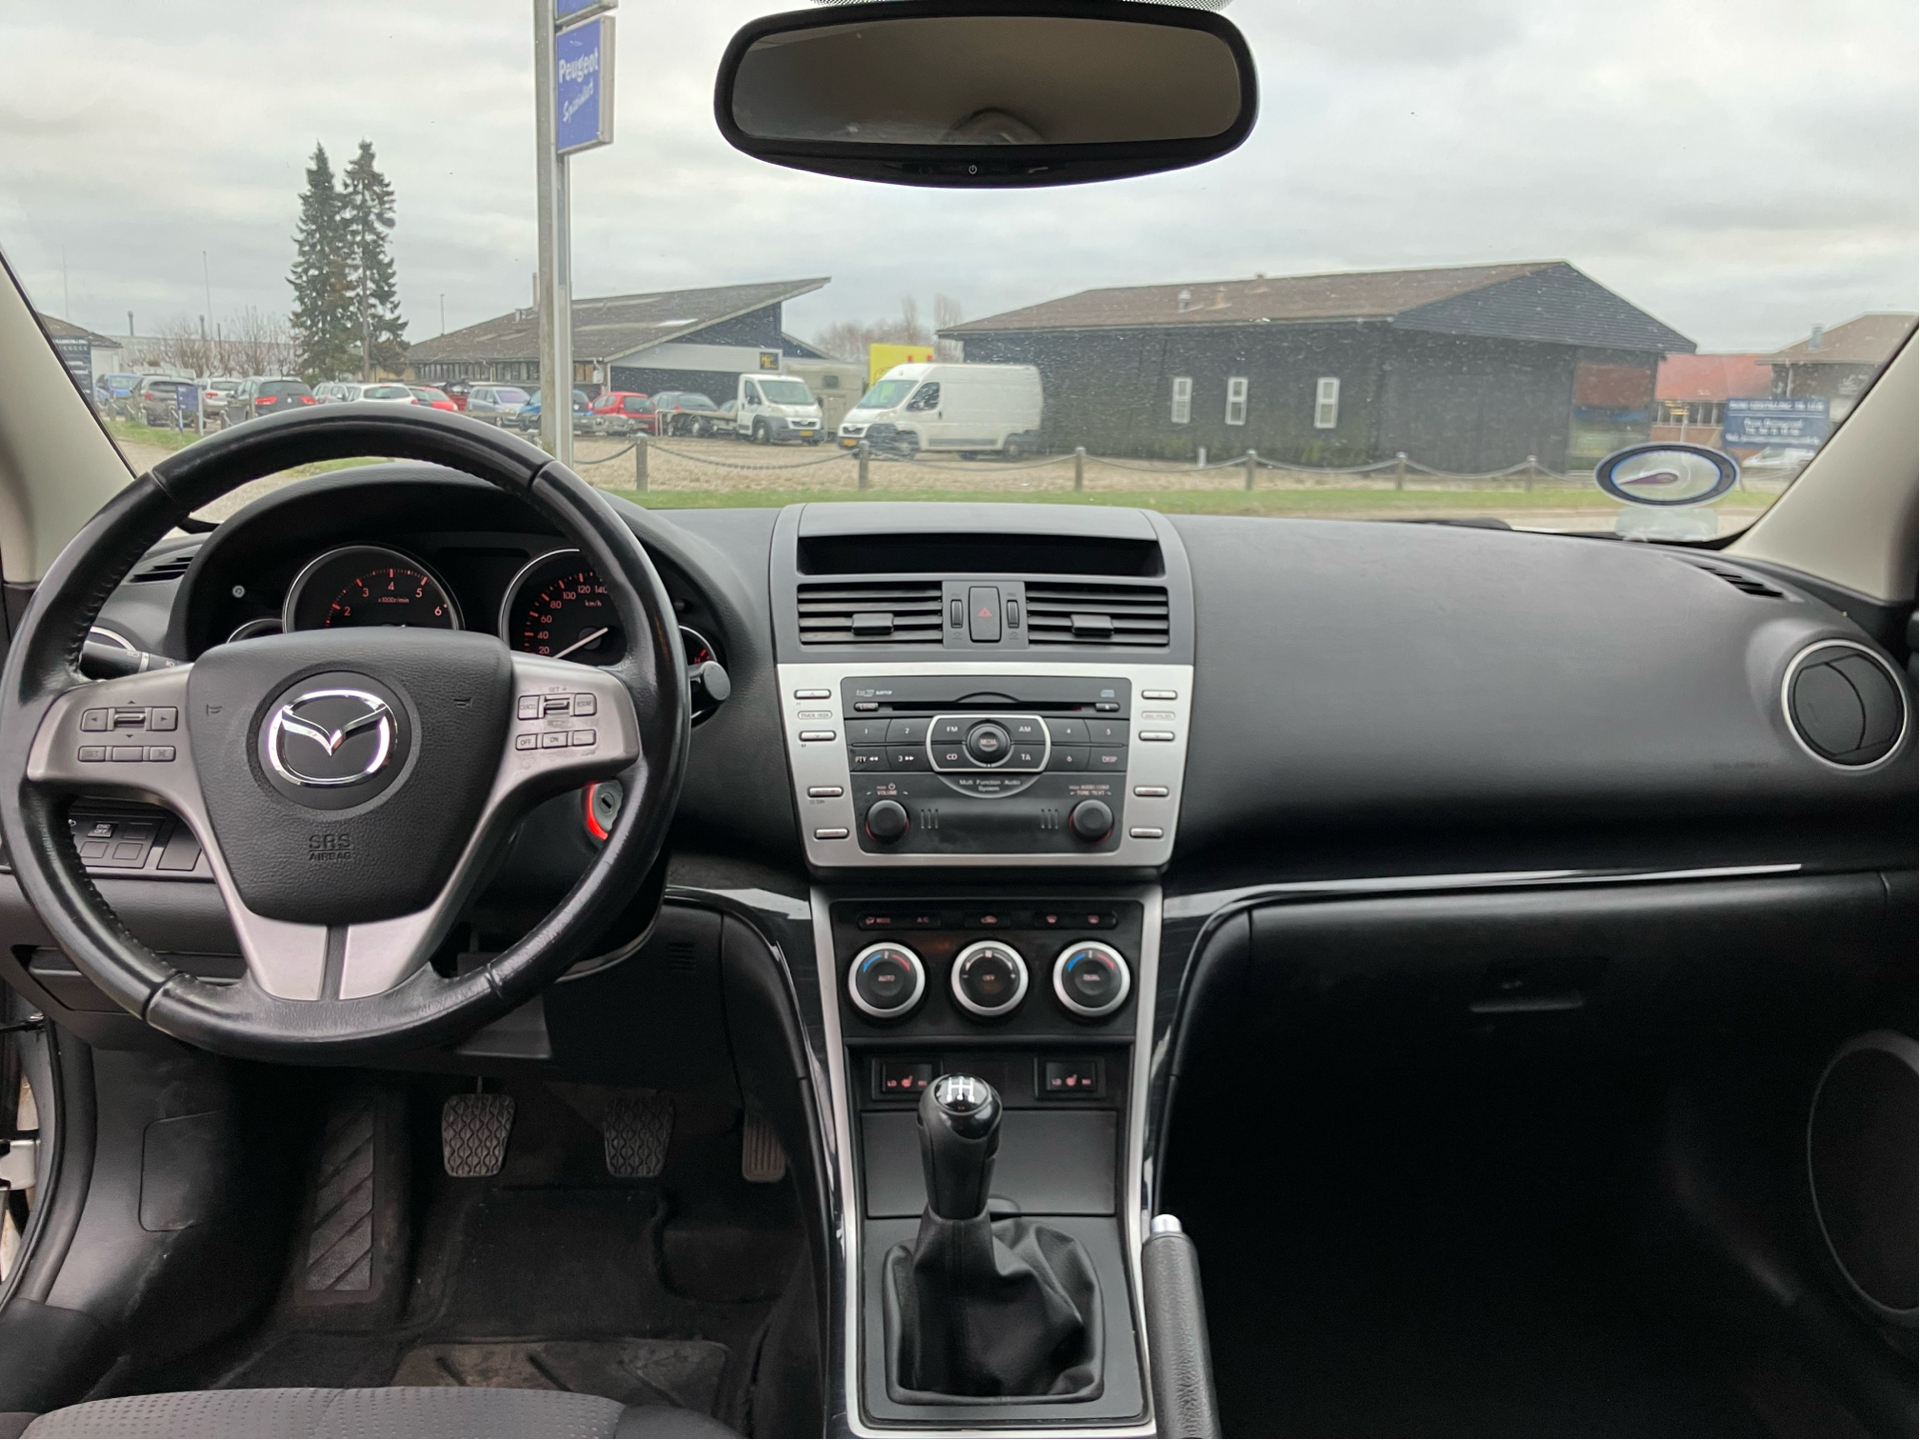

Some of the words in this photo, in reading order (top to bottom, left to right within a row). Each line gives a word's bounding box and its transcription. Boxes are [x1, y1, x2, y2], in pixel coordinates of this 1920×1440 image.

[558, 47, 599, 84] Peugeot
[388, 582, 395, 591] 4
[577, 585, 591, 594] 120
[362, 588, 370, 597] 3
[415, 588, 423, 598] 5
[562, 591, 576, 600] 100
[550, 601, 562, 609] 80
[344, 606, 351, 616] 2
[434, 606, 442, 616] 6
[540, 615, 553, 623] 60
[537, 630, 549, 639] 40
[538, 646, 550, 655] 20
[1020, 753, 1031, 761] TA
[1066, 755, 1073, 763] 6
[308, 833, 351, 849] SRS
[308, 851, 352, 861] AIRBAG
